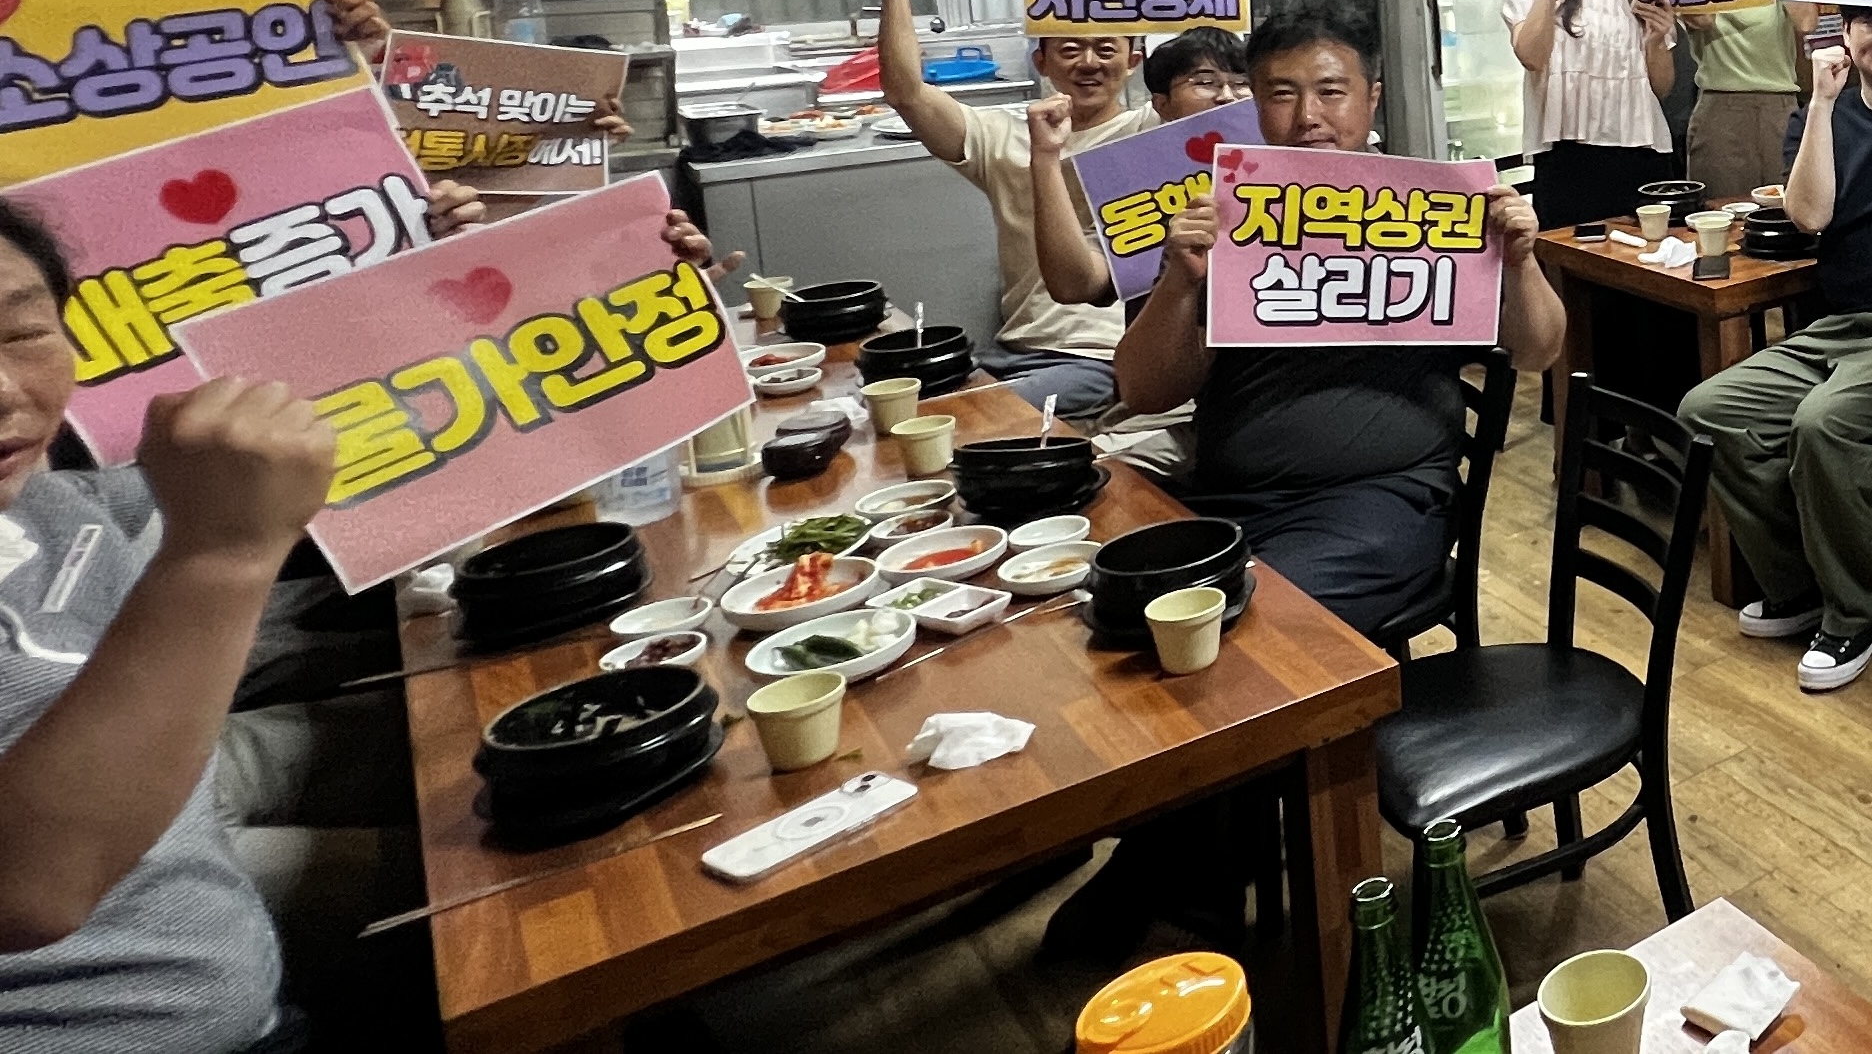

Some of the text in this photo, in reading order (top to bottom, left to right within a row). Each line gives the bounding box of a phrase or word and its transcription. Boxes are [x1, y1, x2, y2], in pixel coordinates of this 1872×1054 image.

[416, 83, 492, 119] 추석
[497, 89, 596, 123] 맞이는
[1231, 183, 1490, 253] 지역상권
[1251, 255, 1458, 326] 살리기
